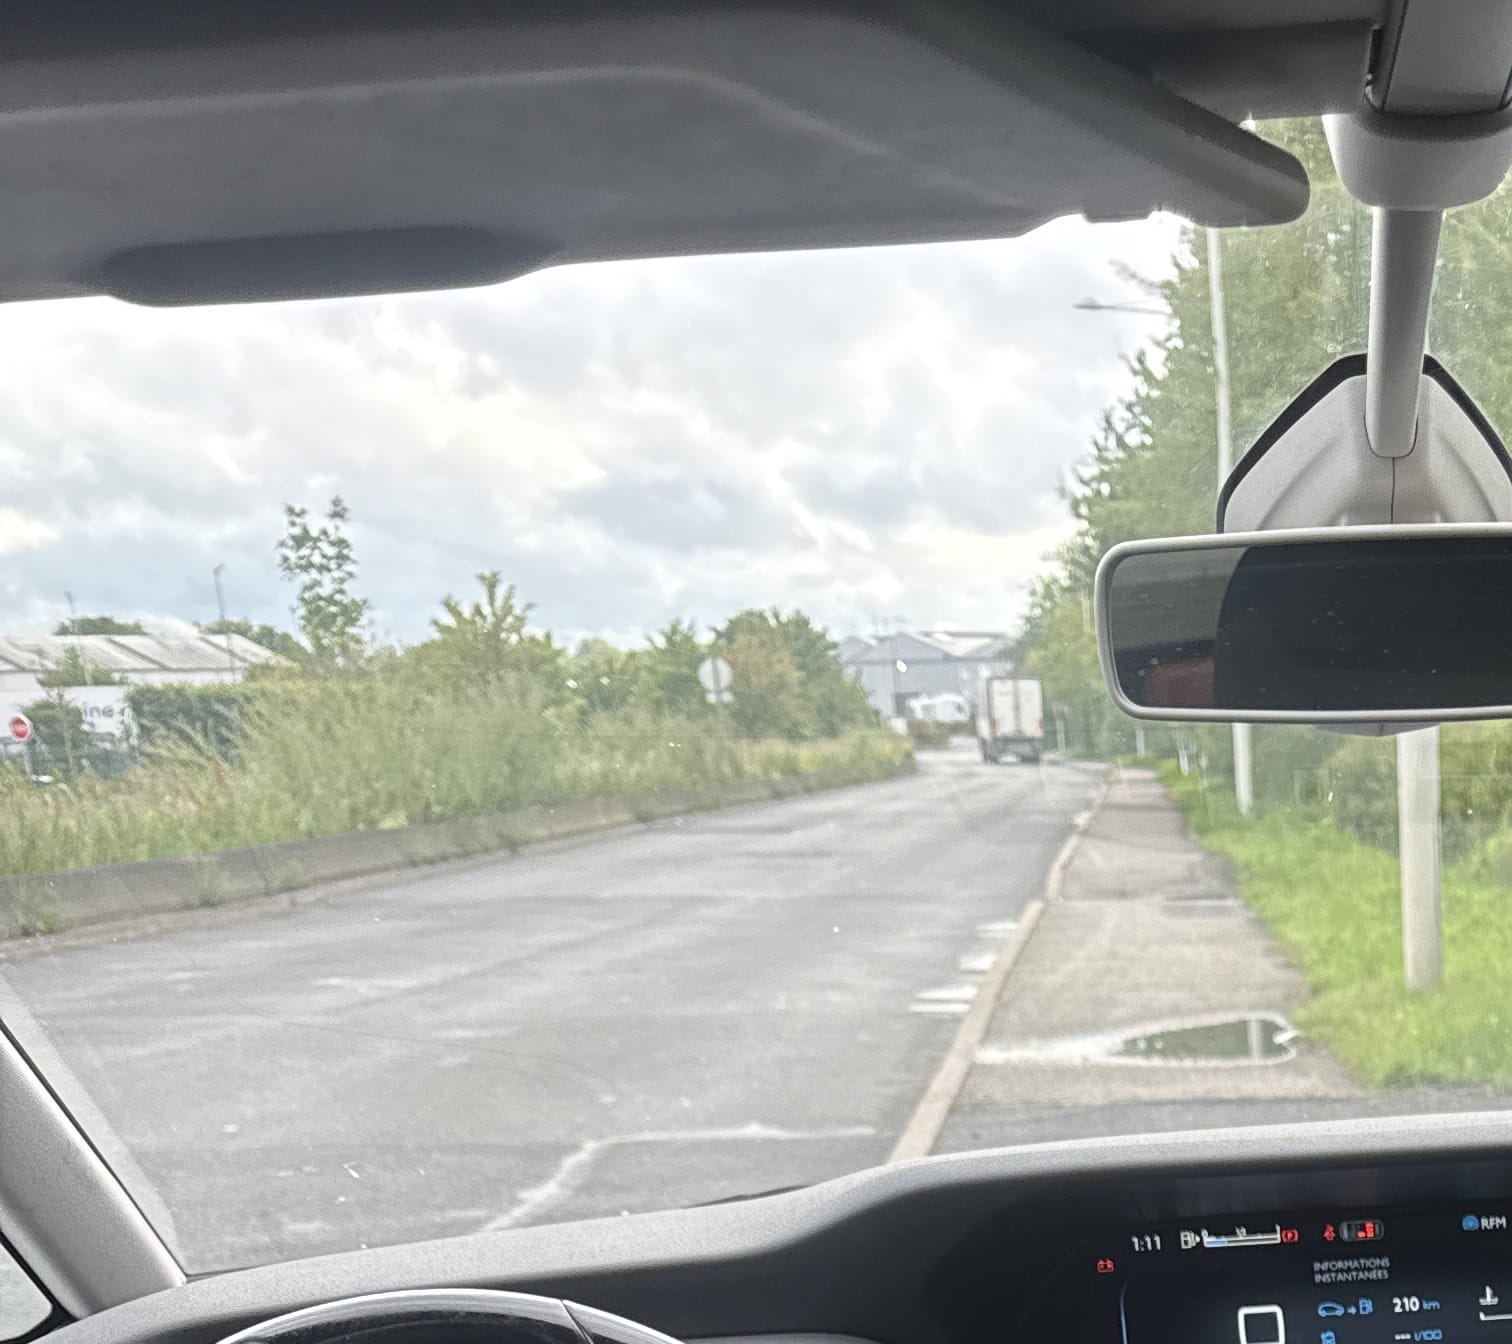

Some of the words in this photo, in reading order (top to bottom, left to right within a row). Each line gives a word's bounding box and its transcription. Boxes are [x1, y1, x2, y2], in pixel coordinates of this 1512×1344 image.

[1481, 1215, 1507, 1230] RFM
[1313, 1257, 1391, 1272] INFORMATIONS
[1392, 1295, 1420, 1313] 210
